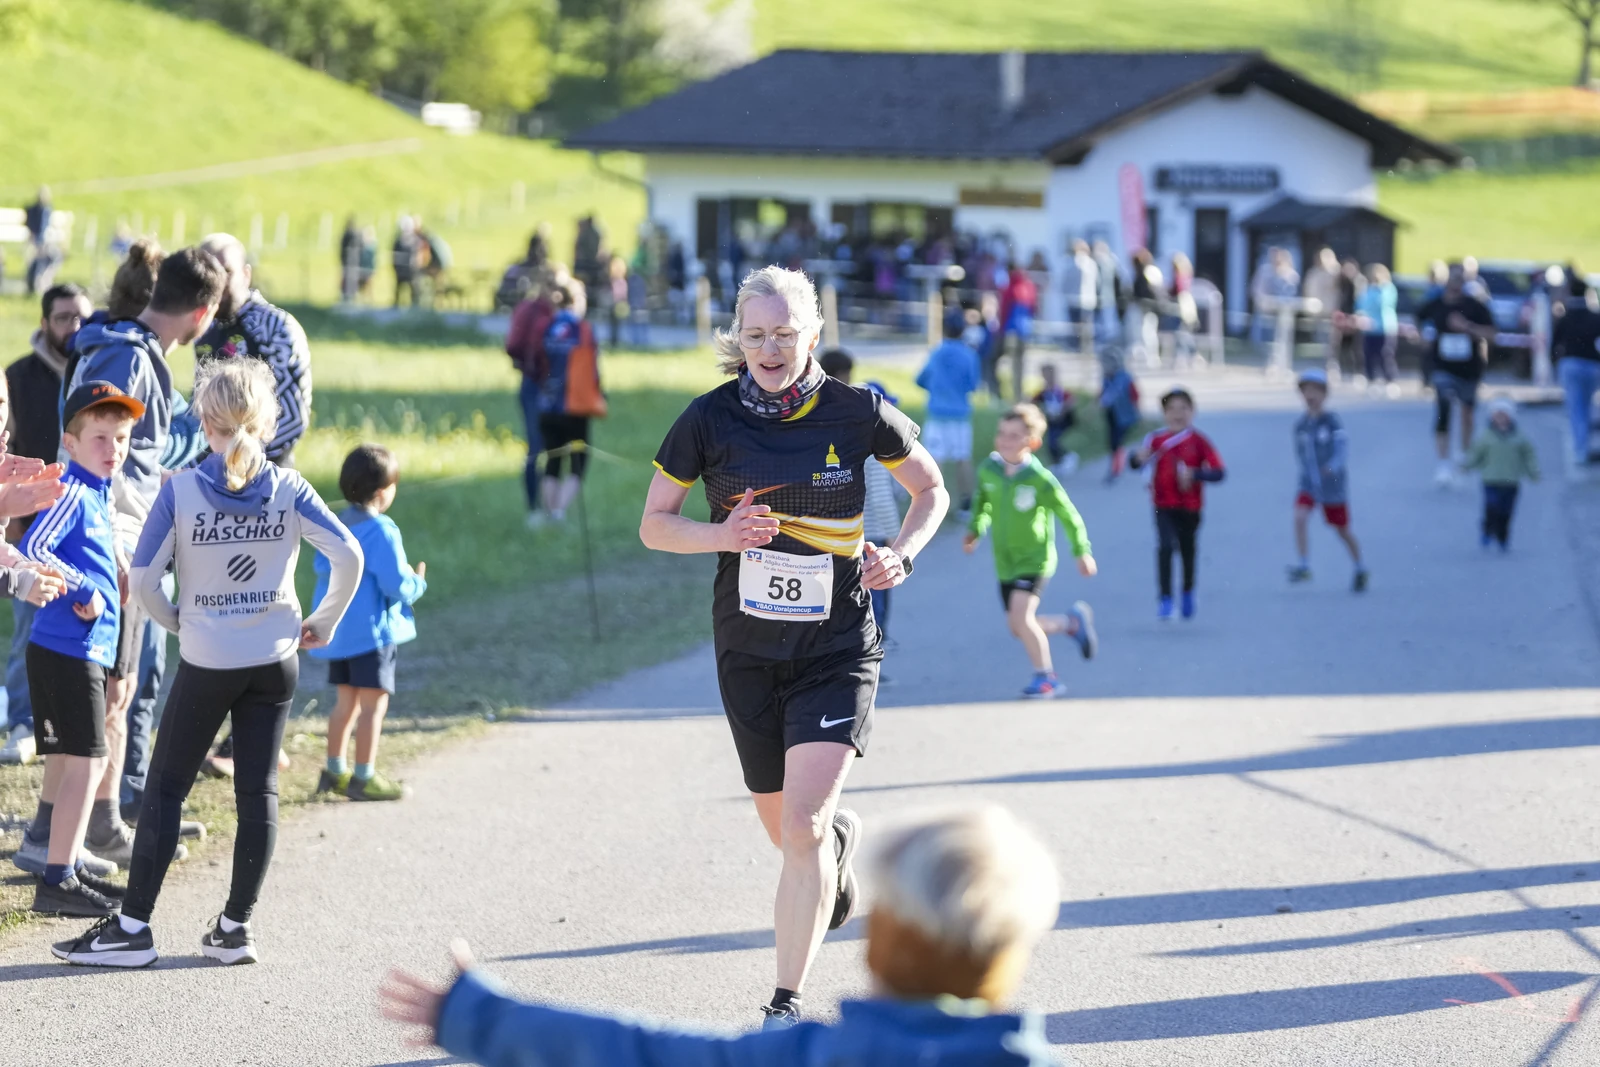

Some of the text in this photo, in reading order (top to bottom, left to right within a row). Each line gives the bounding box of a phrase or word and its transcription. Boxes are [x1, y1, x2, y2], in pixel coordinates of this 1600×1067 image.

[821, 469, 851, 480] DRESDEN
[812, 476, 853, 487] MARATHON
[194, 510, 287, 527] SPORT
[191, 523, 286, 542] HASCHKO
[764, 553, 790, 562] Volksbank
[767, 575, 802, 602] 58
[231, 606, 269, 615] HOLZMACHER
[755, 602, 773, 611] VBAO
